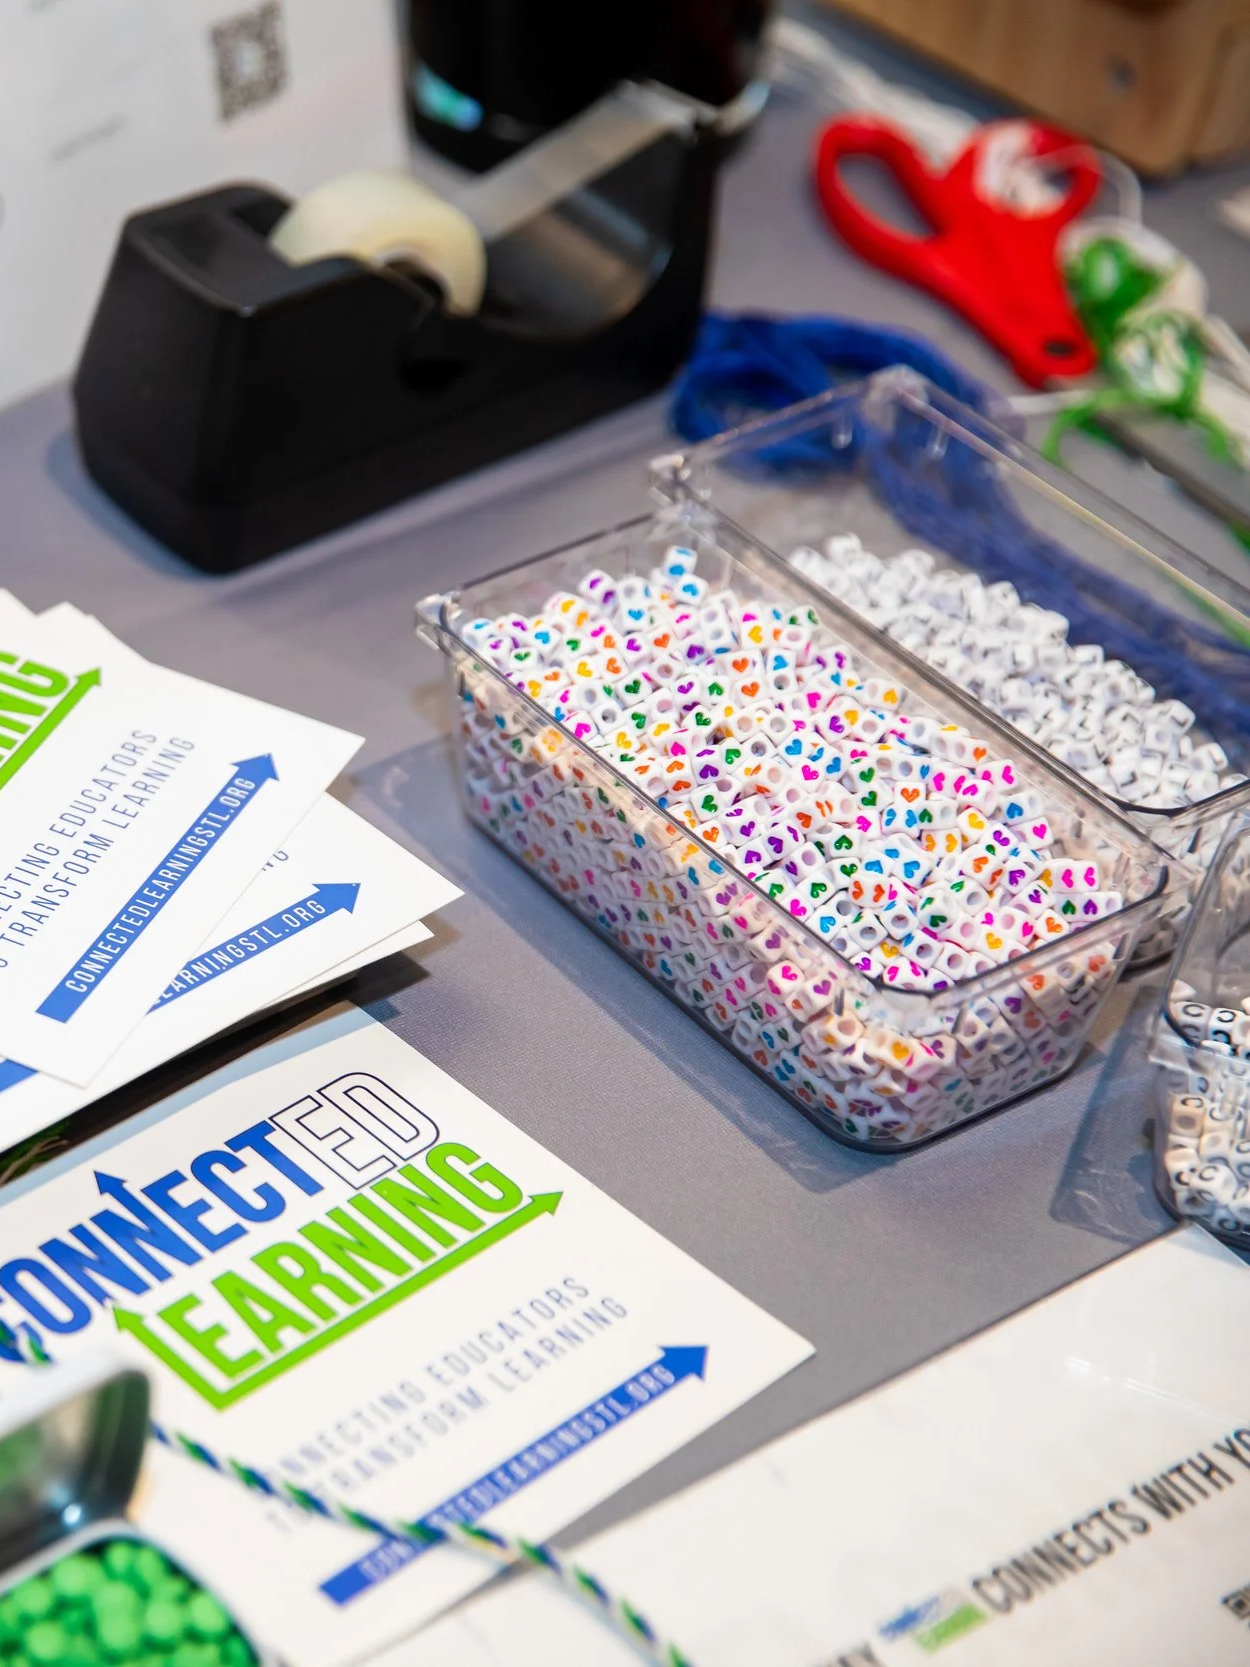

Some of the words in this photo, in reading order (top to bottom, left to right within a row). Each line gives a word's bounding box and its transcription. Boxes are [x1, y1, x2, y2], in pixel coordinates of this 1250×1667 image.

[49, 729, 158, 838] EDUCATORS
[101, 737, 195, 829] LEARNING
[65, 776, 256, 993] CONNECTEDLEARNINGSTL.ORG
[157, 899, 326, 1003] ARNINGSTL.ORG
[113, 1142, 524, 1412] LEARNING
[272, 1378, 427, 1480] NNECTING
[426, 1277, 590, 1387] EDUCATORS
[487, 1297, 628, 1393] LEARNING
[972, 1499, 1152, 1614] CONNECTS
[1131, 1452, 1235, 1521] WITH
